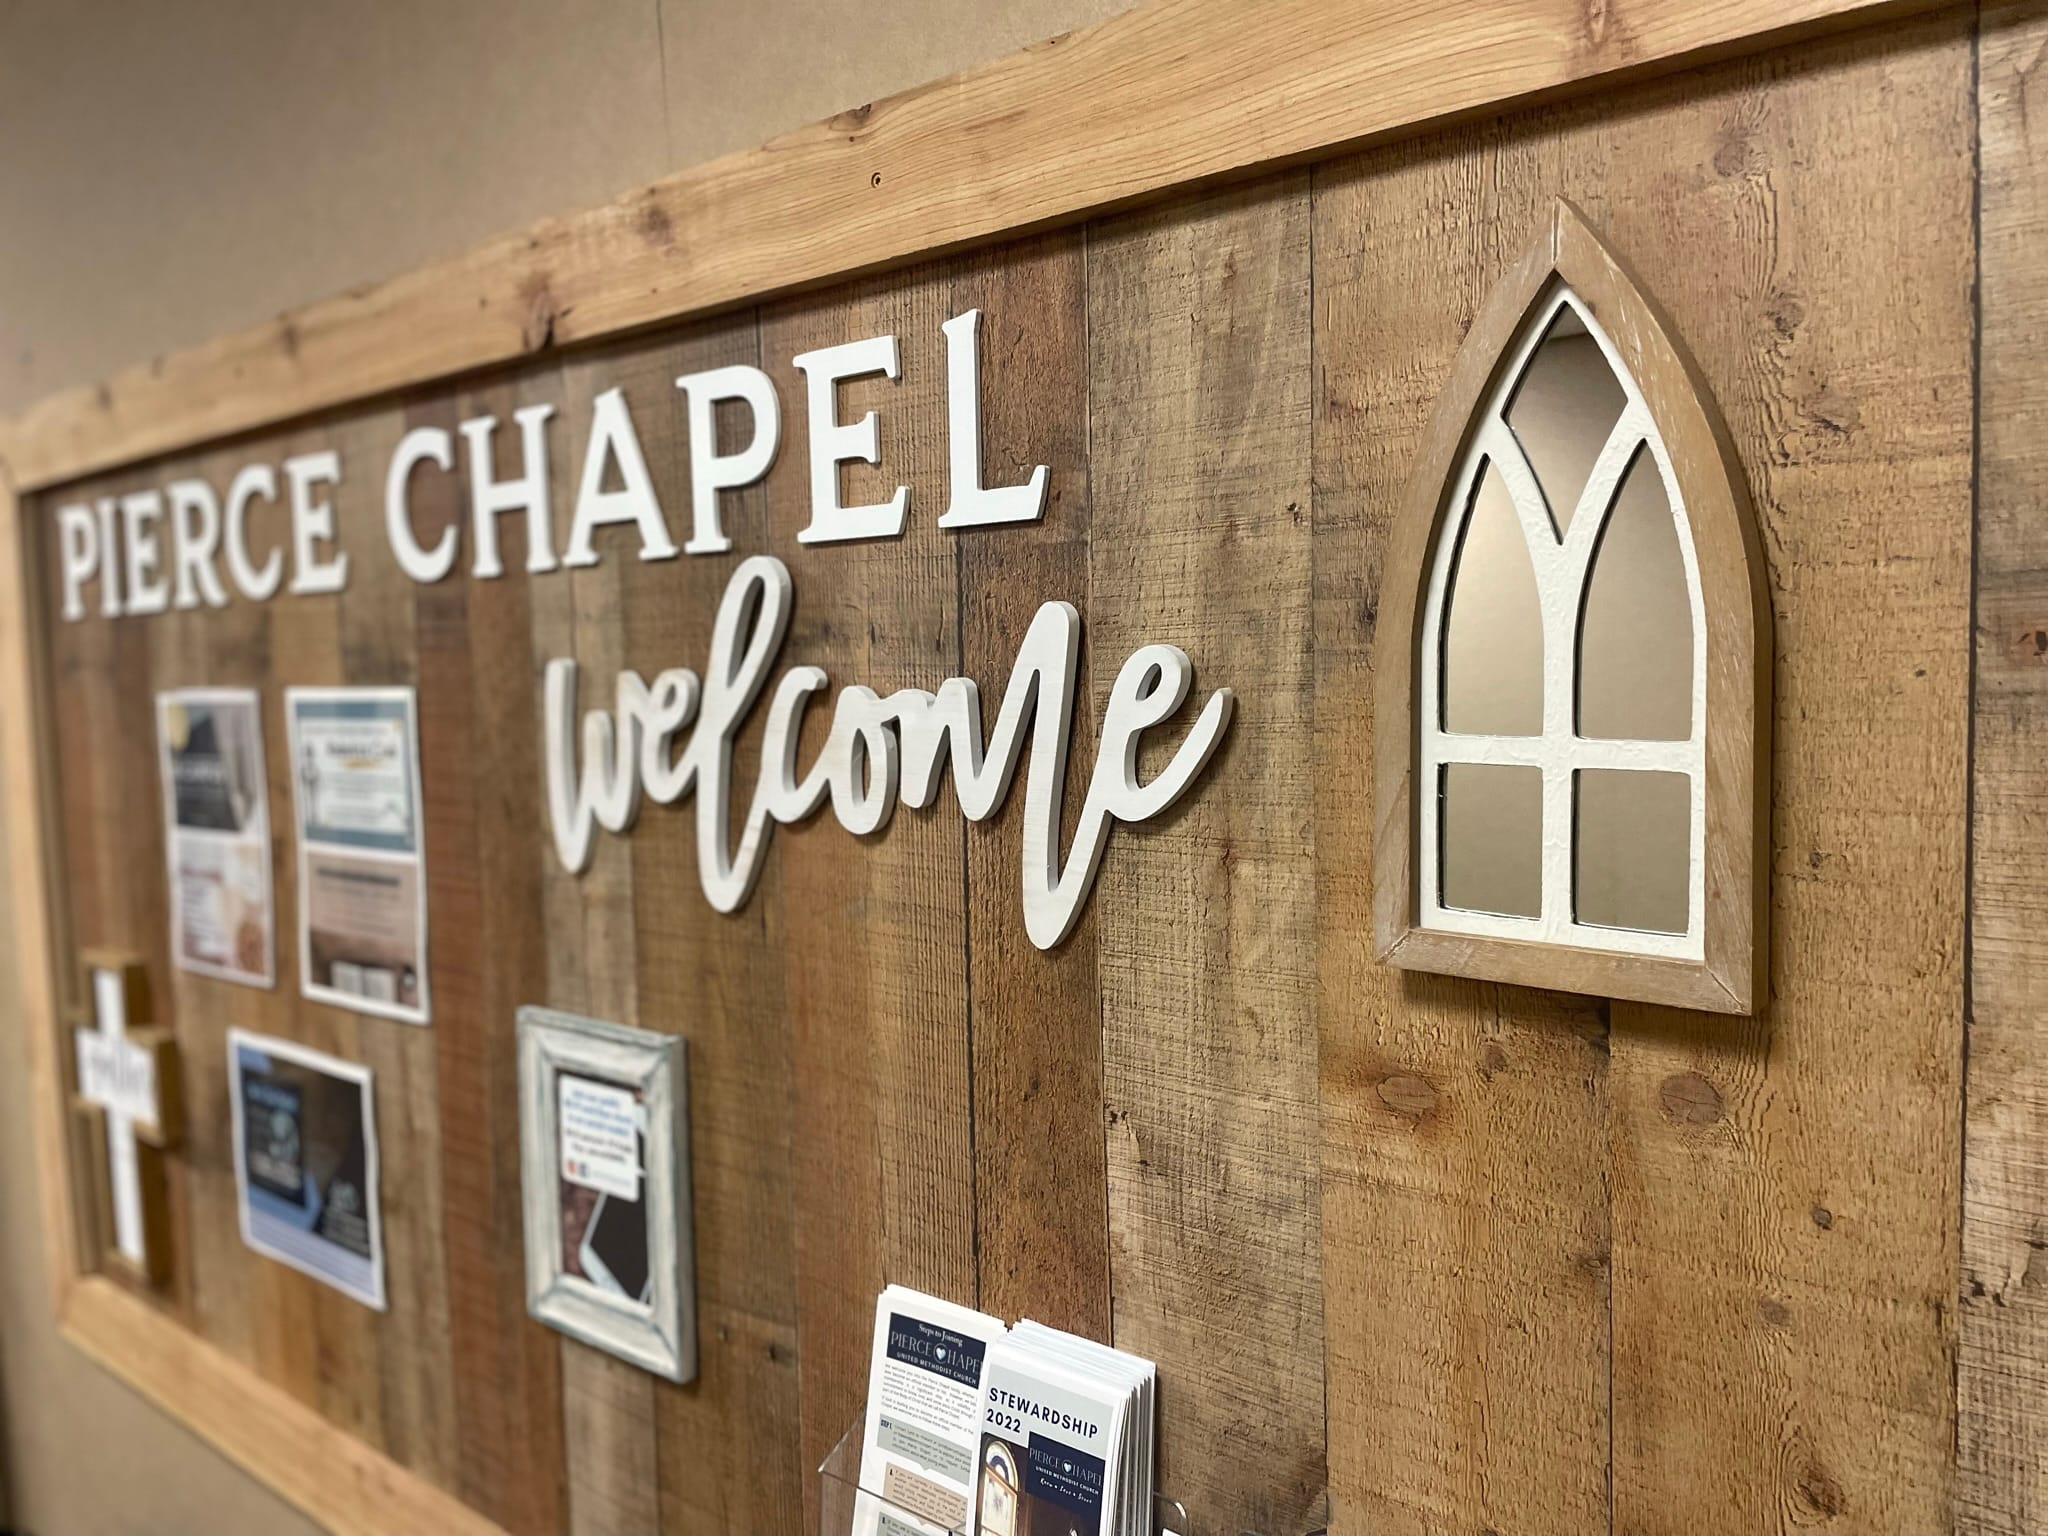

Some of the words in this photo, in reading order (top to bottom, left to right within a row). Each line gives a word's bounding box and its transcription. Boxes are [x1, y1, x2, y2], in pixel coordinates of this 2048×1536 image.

[57, 451, 348, 621] PIERCE
[386, 308, 1050, 582] CHAPEL
[545, 555, 1232, 950] welcome
[891, 1331, 932, 1356] PIERCE
[897, 1351, 918, 1363] UNITED
[920, 1359, 952, 1375] METHODIST
[953, 1371, 976, 1385] CHURCH
[986, 1408, 1021, 1433] 2022
[989, 1388, 1098, 1438] STEWARDSHIP
[1029, 1447, 1059, 1468] PIERCE
[1053, 1473, 1079, 1486] METHODIST
[1080, 1482, 1099, 1495] CHURCH
